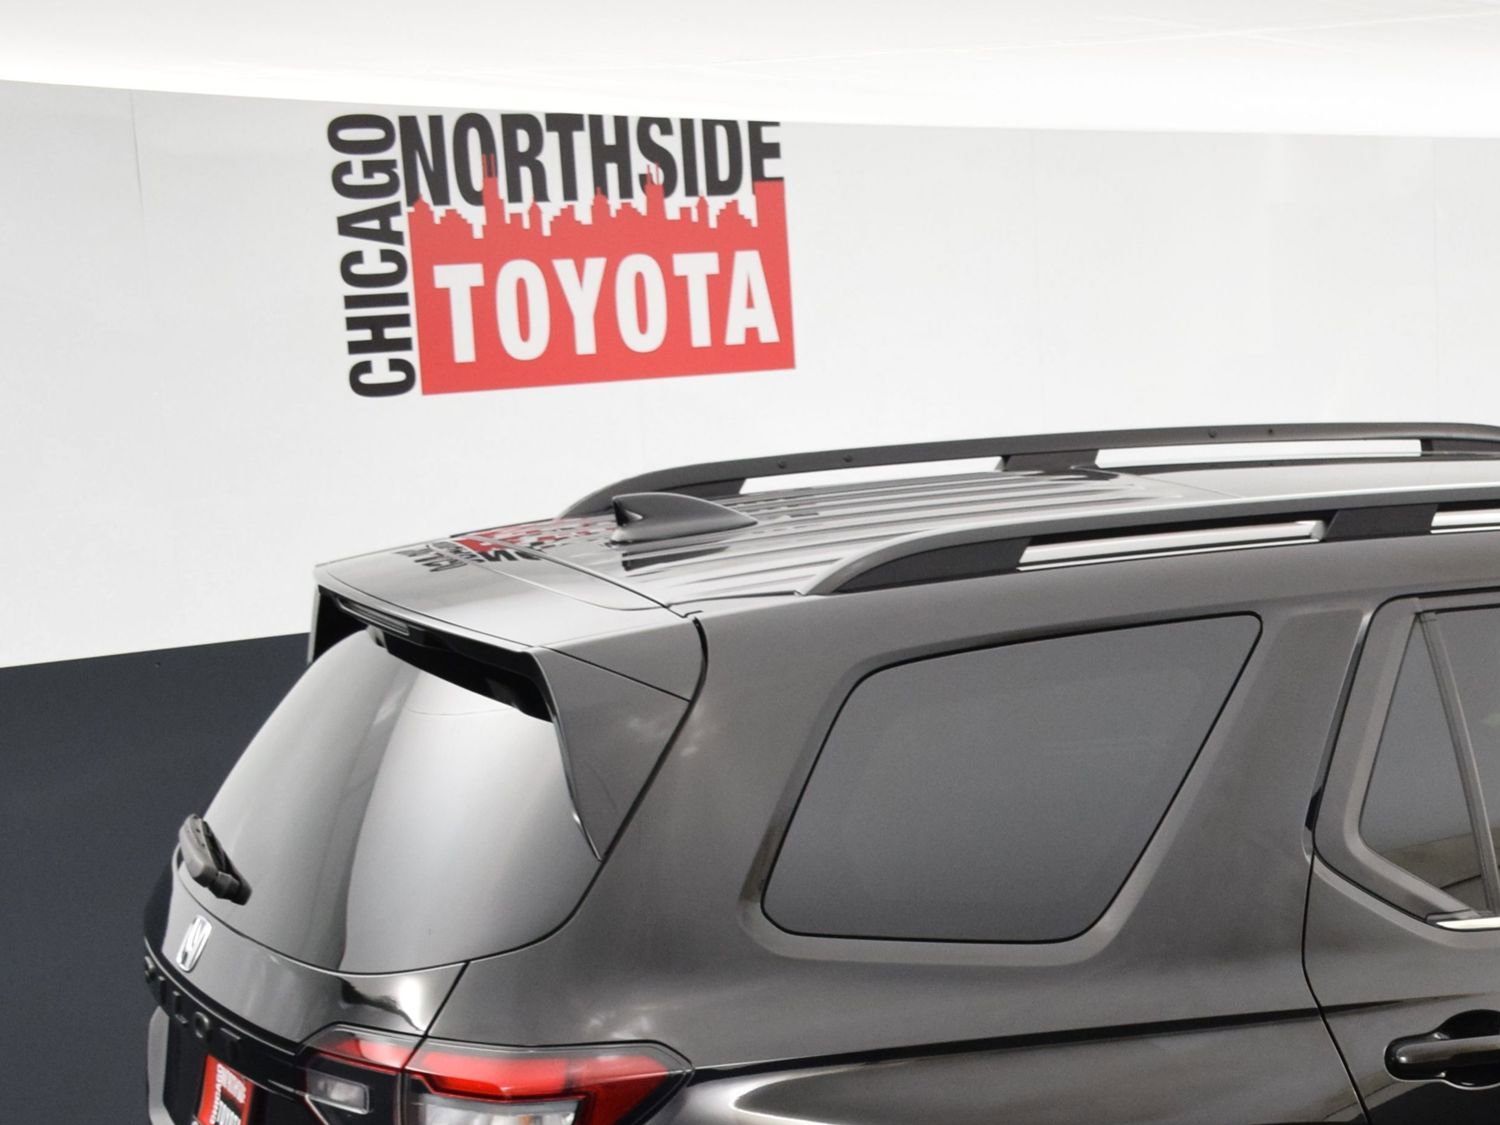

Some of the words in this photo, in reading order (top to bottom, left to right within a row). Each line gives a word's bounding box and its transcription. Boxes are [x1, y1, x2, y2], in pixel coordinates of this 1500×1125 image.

[399, 112, 784, 206] NORTHSIDE
[327, 113, 416, 397] CHICAGO
[433, 250, 780, 363] TOYOTA
